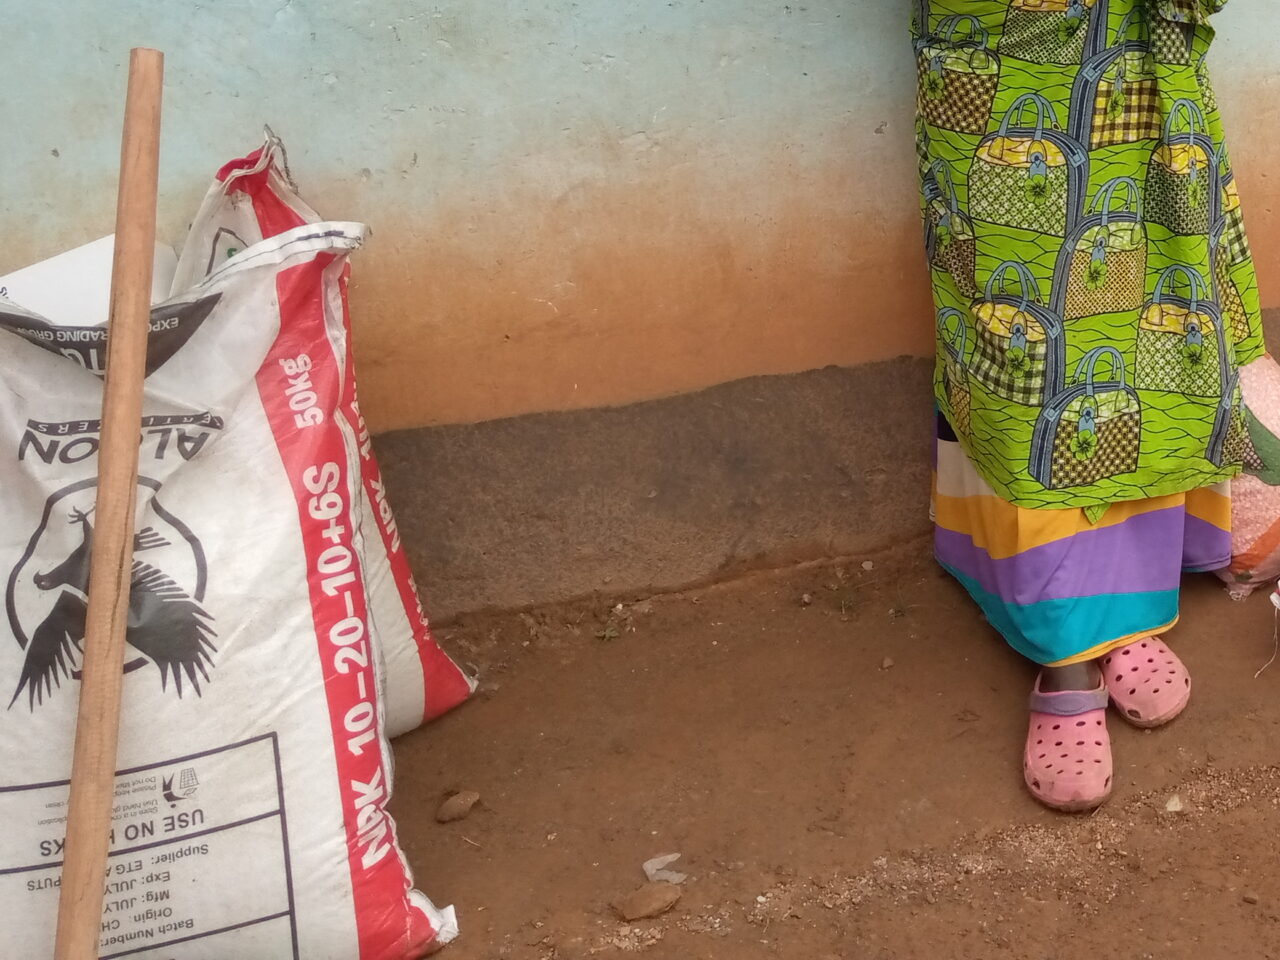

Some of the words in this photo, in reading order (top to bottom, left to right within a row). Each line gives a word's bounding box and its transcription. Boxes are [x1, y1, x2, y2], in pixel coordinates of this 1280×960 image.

[303, 461, 376, 757] 10-20-10+6S
[164, 808, 205, 833] USE
[350, 765, 392, 870] NPK
[124, 820, 154, 841] NO
[150, 844, 209, 865] Supplier:
[115, 859, 143, 875] ETG
[141, 870, 171, 885] Exp:
[103, 878, 137, 895] JULY
[141, 889, 170, 902] Mfg:
[103, 897, 137, 914] JULY
[158, 919, 194, 934] Batch
[100, 929, 154, 947] Number:
